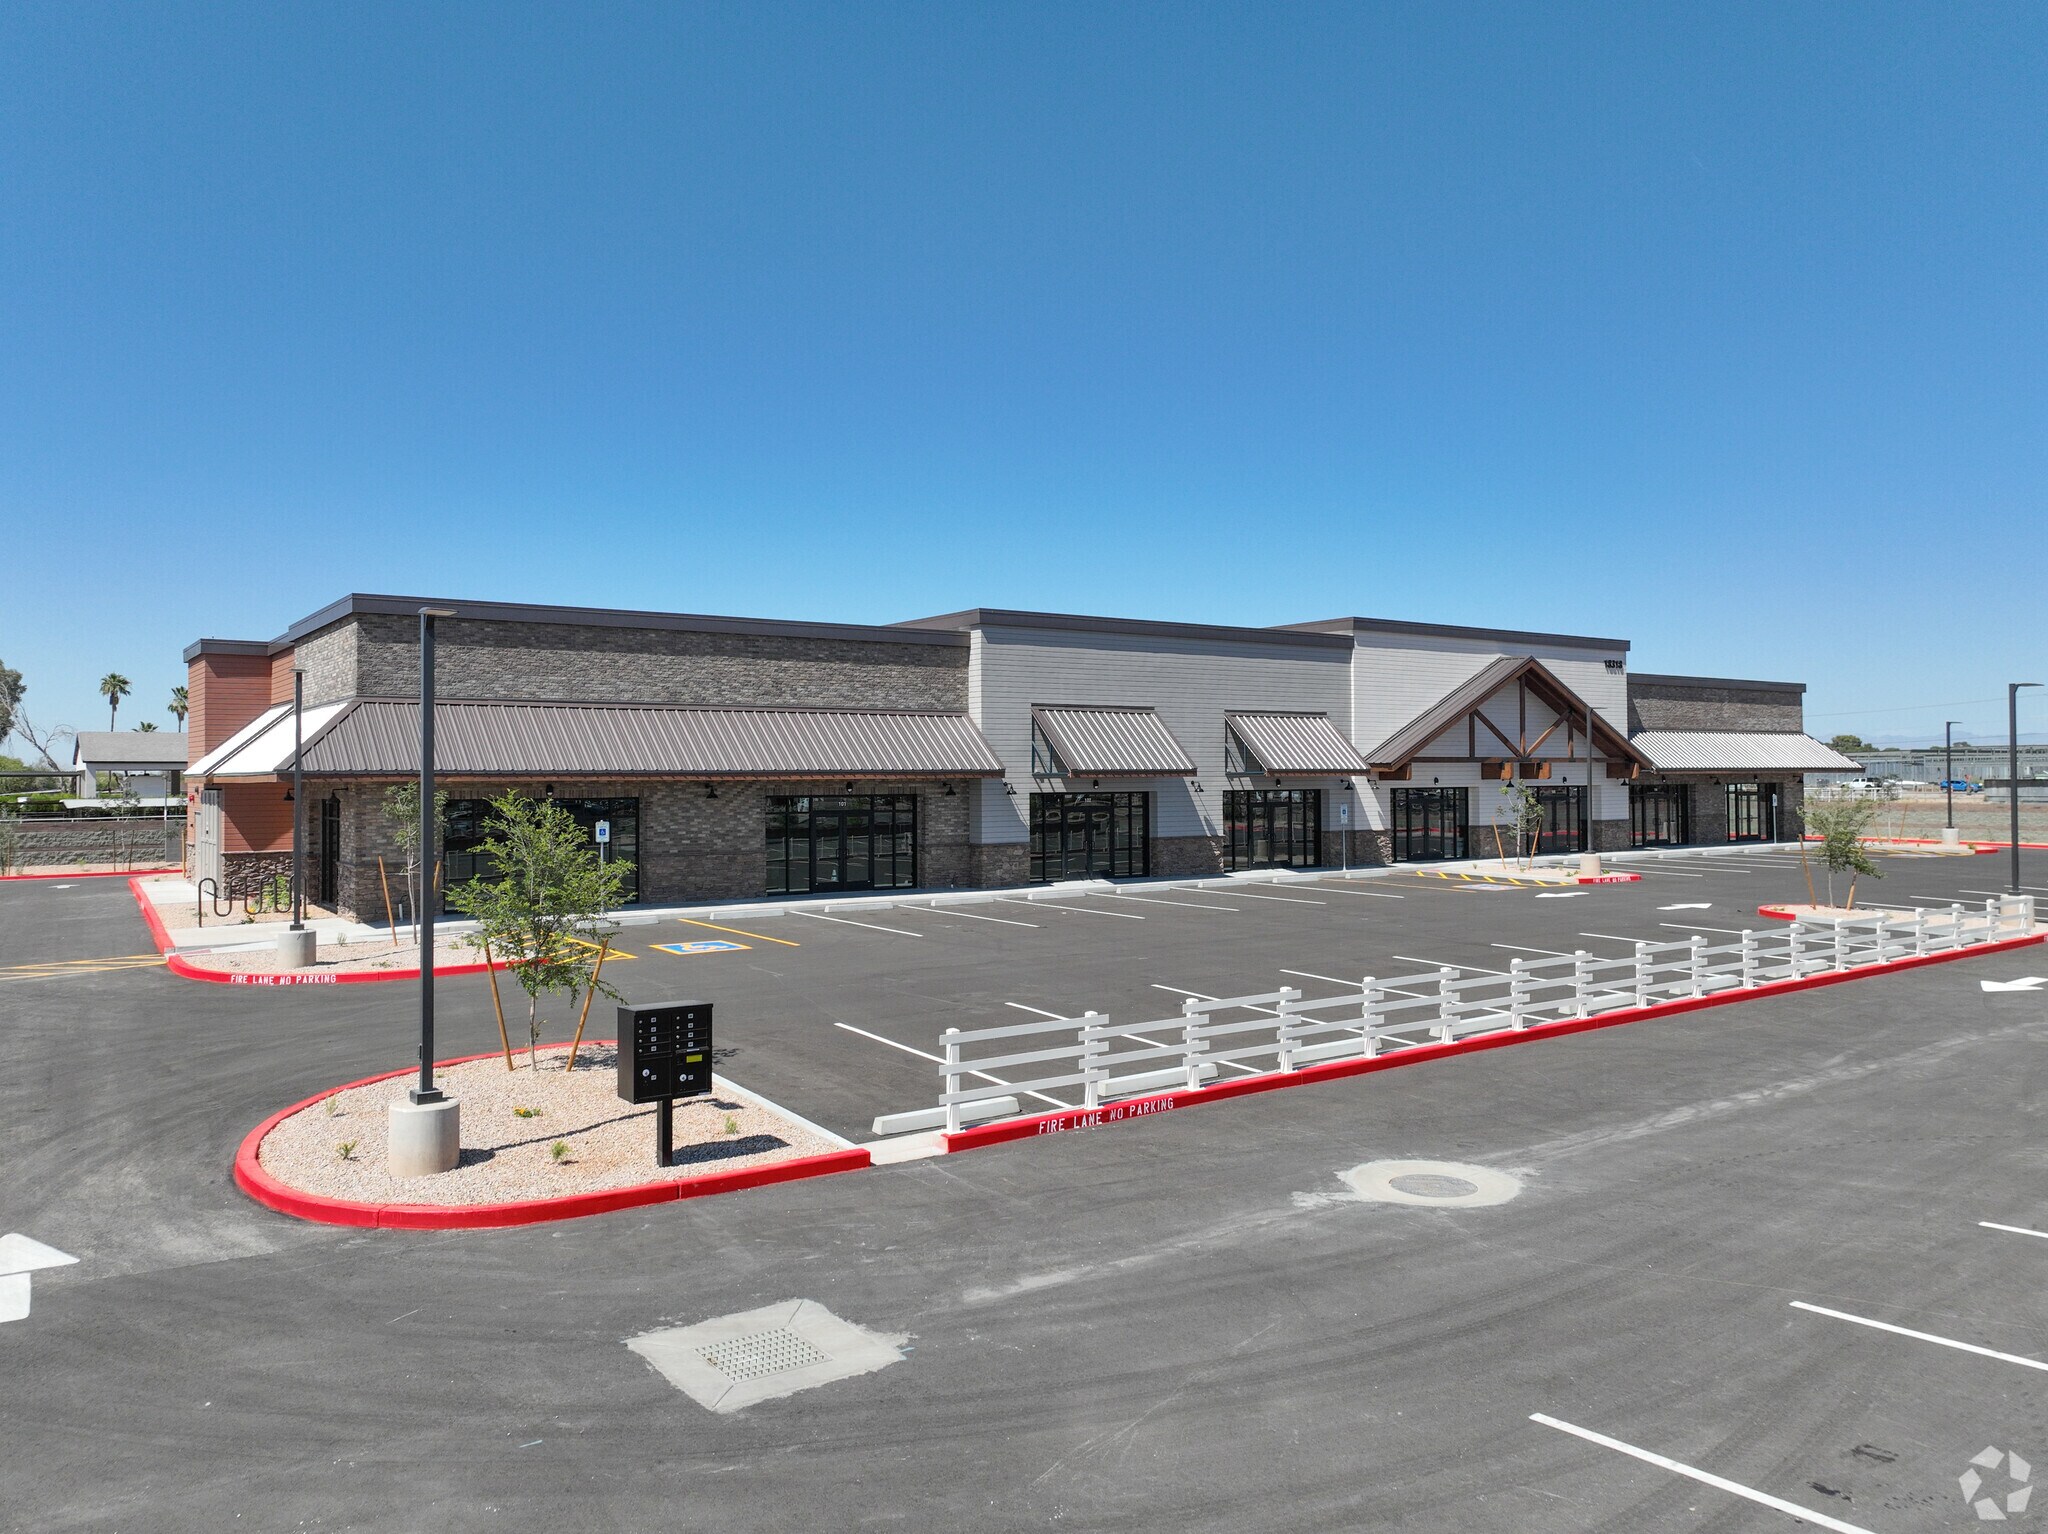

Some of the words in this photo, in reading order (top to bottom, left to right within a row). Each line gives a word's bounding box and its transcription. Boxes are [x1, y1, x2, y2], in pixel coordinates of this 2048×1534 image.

[230, 974, 248, 984] FIRE
[253, 975, 275, 986] LANE
[279, 976, 292, 985] NO
[296, 974, 337, 984] PARKING
[1038, 1117, 1065, 1134] FIRE
[1074, 1111, 1103, 1129] LANE
[1109, 1108, 1124, 1121] NO
[1129, 1097, 1174, 1117] PARKING
